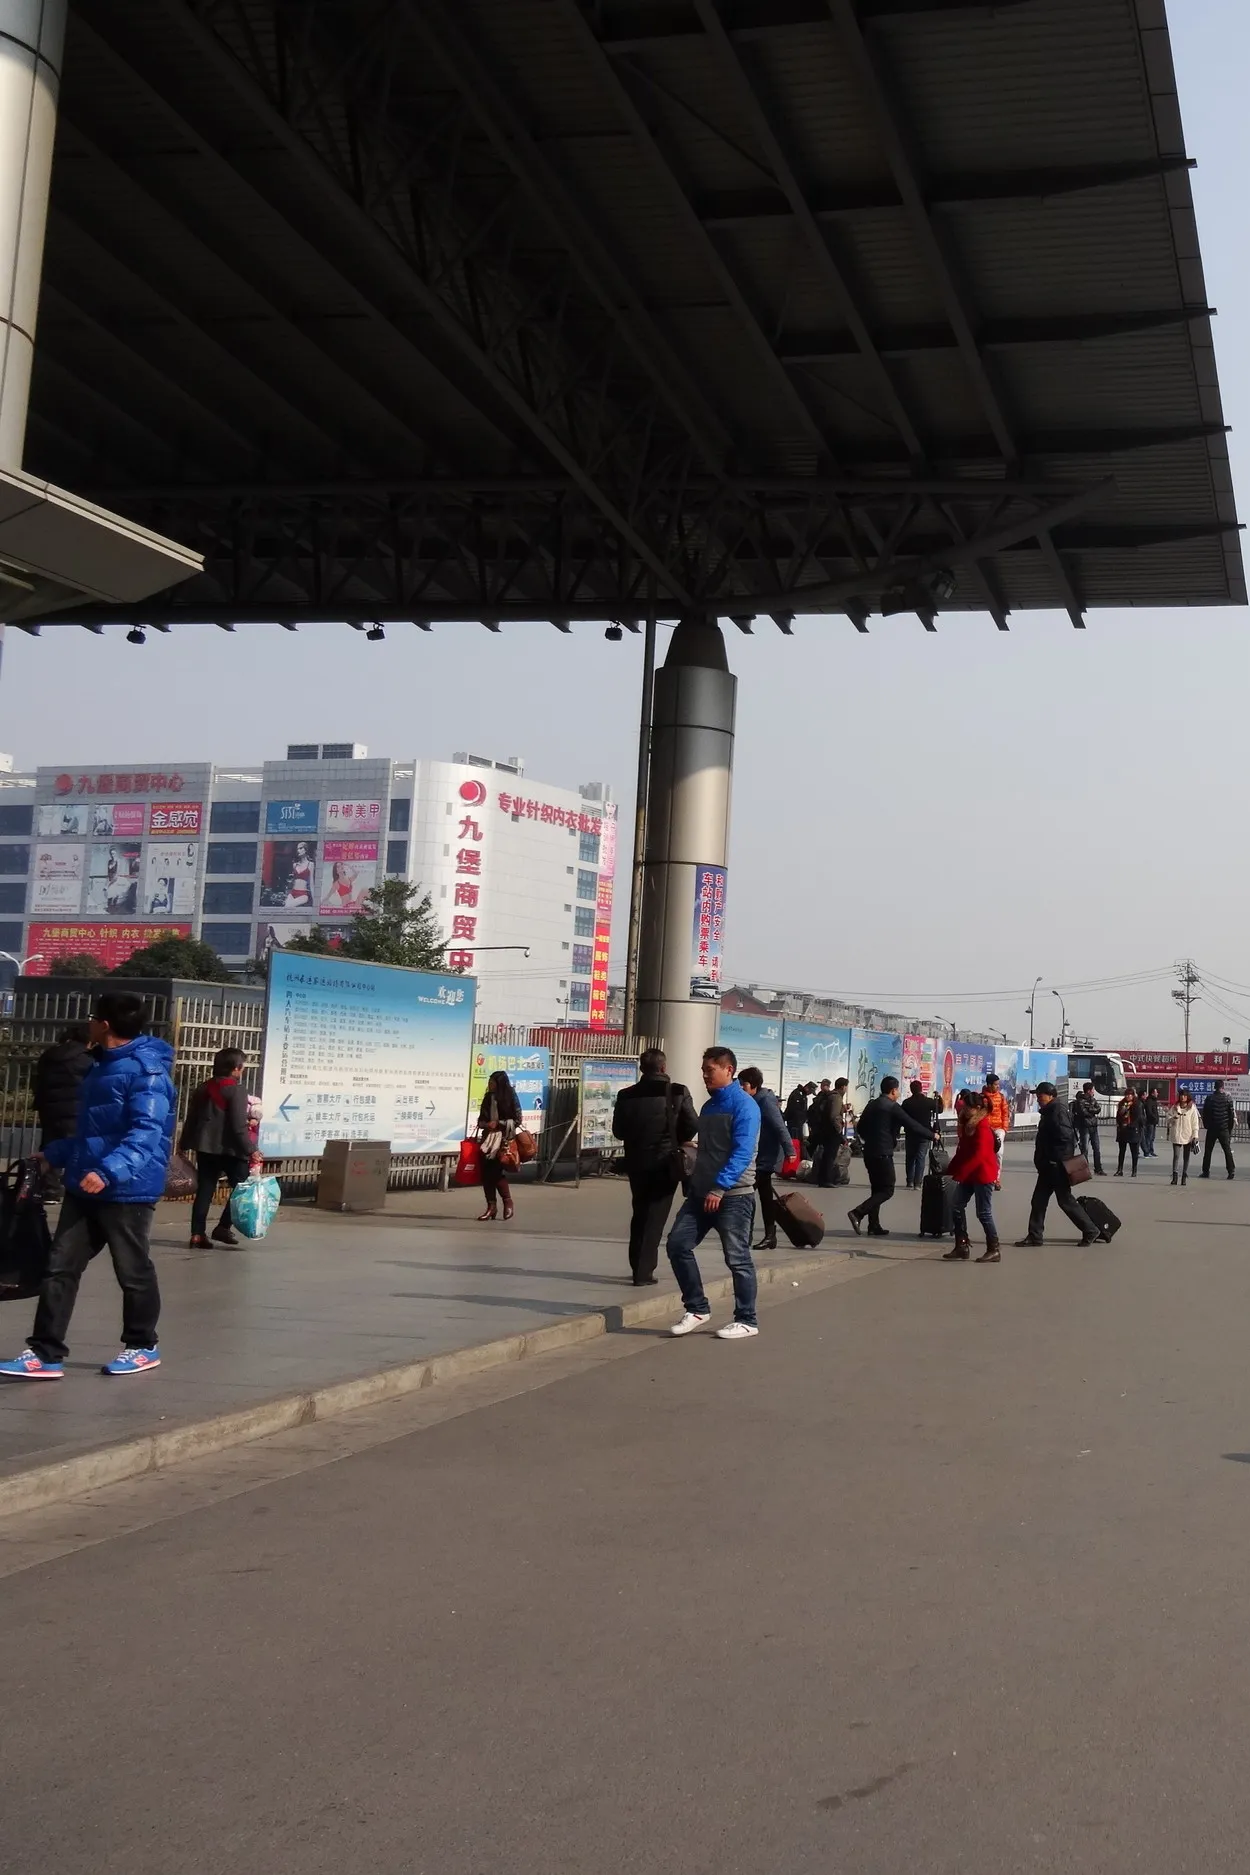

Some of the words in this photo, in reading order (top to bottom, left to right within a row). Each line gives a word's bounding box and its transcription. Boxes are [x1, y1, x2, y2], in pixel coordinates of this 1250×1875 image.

[77, 773, 185, 795] 九堡商贸中心
[329, 804, 380, 819] 丹娜美甲
[498, 792, 602, 837] 专业针织内衣批发
[151, 810, 199, 829] 金感觉
[42, 927, 96, 938] 九堡商贸中心
[100, 927, 118, 938] 针织
[121, 928, 140, 938] 内衣
[417, 995, 447, 1005] WELCOME
[437, 985, 465, 1006] 欢迎您
[591, 1009, 605, 1020] 内衣
[488, 1054, 526, 1071] 机场巴士
[1129, 1054, 1178, 1063] 中式快餐超市
[1195, 1055, 1241, 1065] 便利店
[1188, 1081, 1204, 1092] 公交车
[25, 1359, 42, 1371] N
[132, 1355, 149, 1366] N
